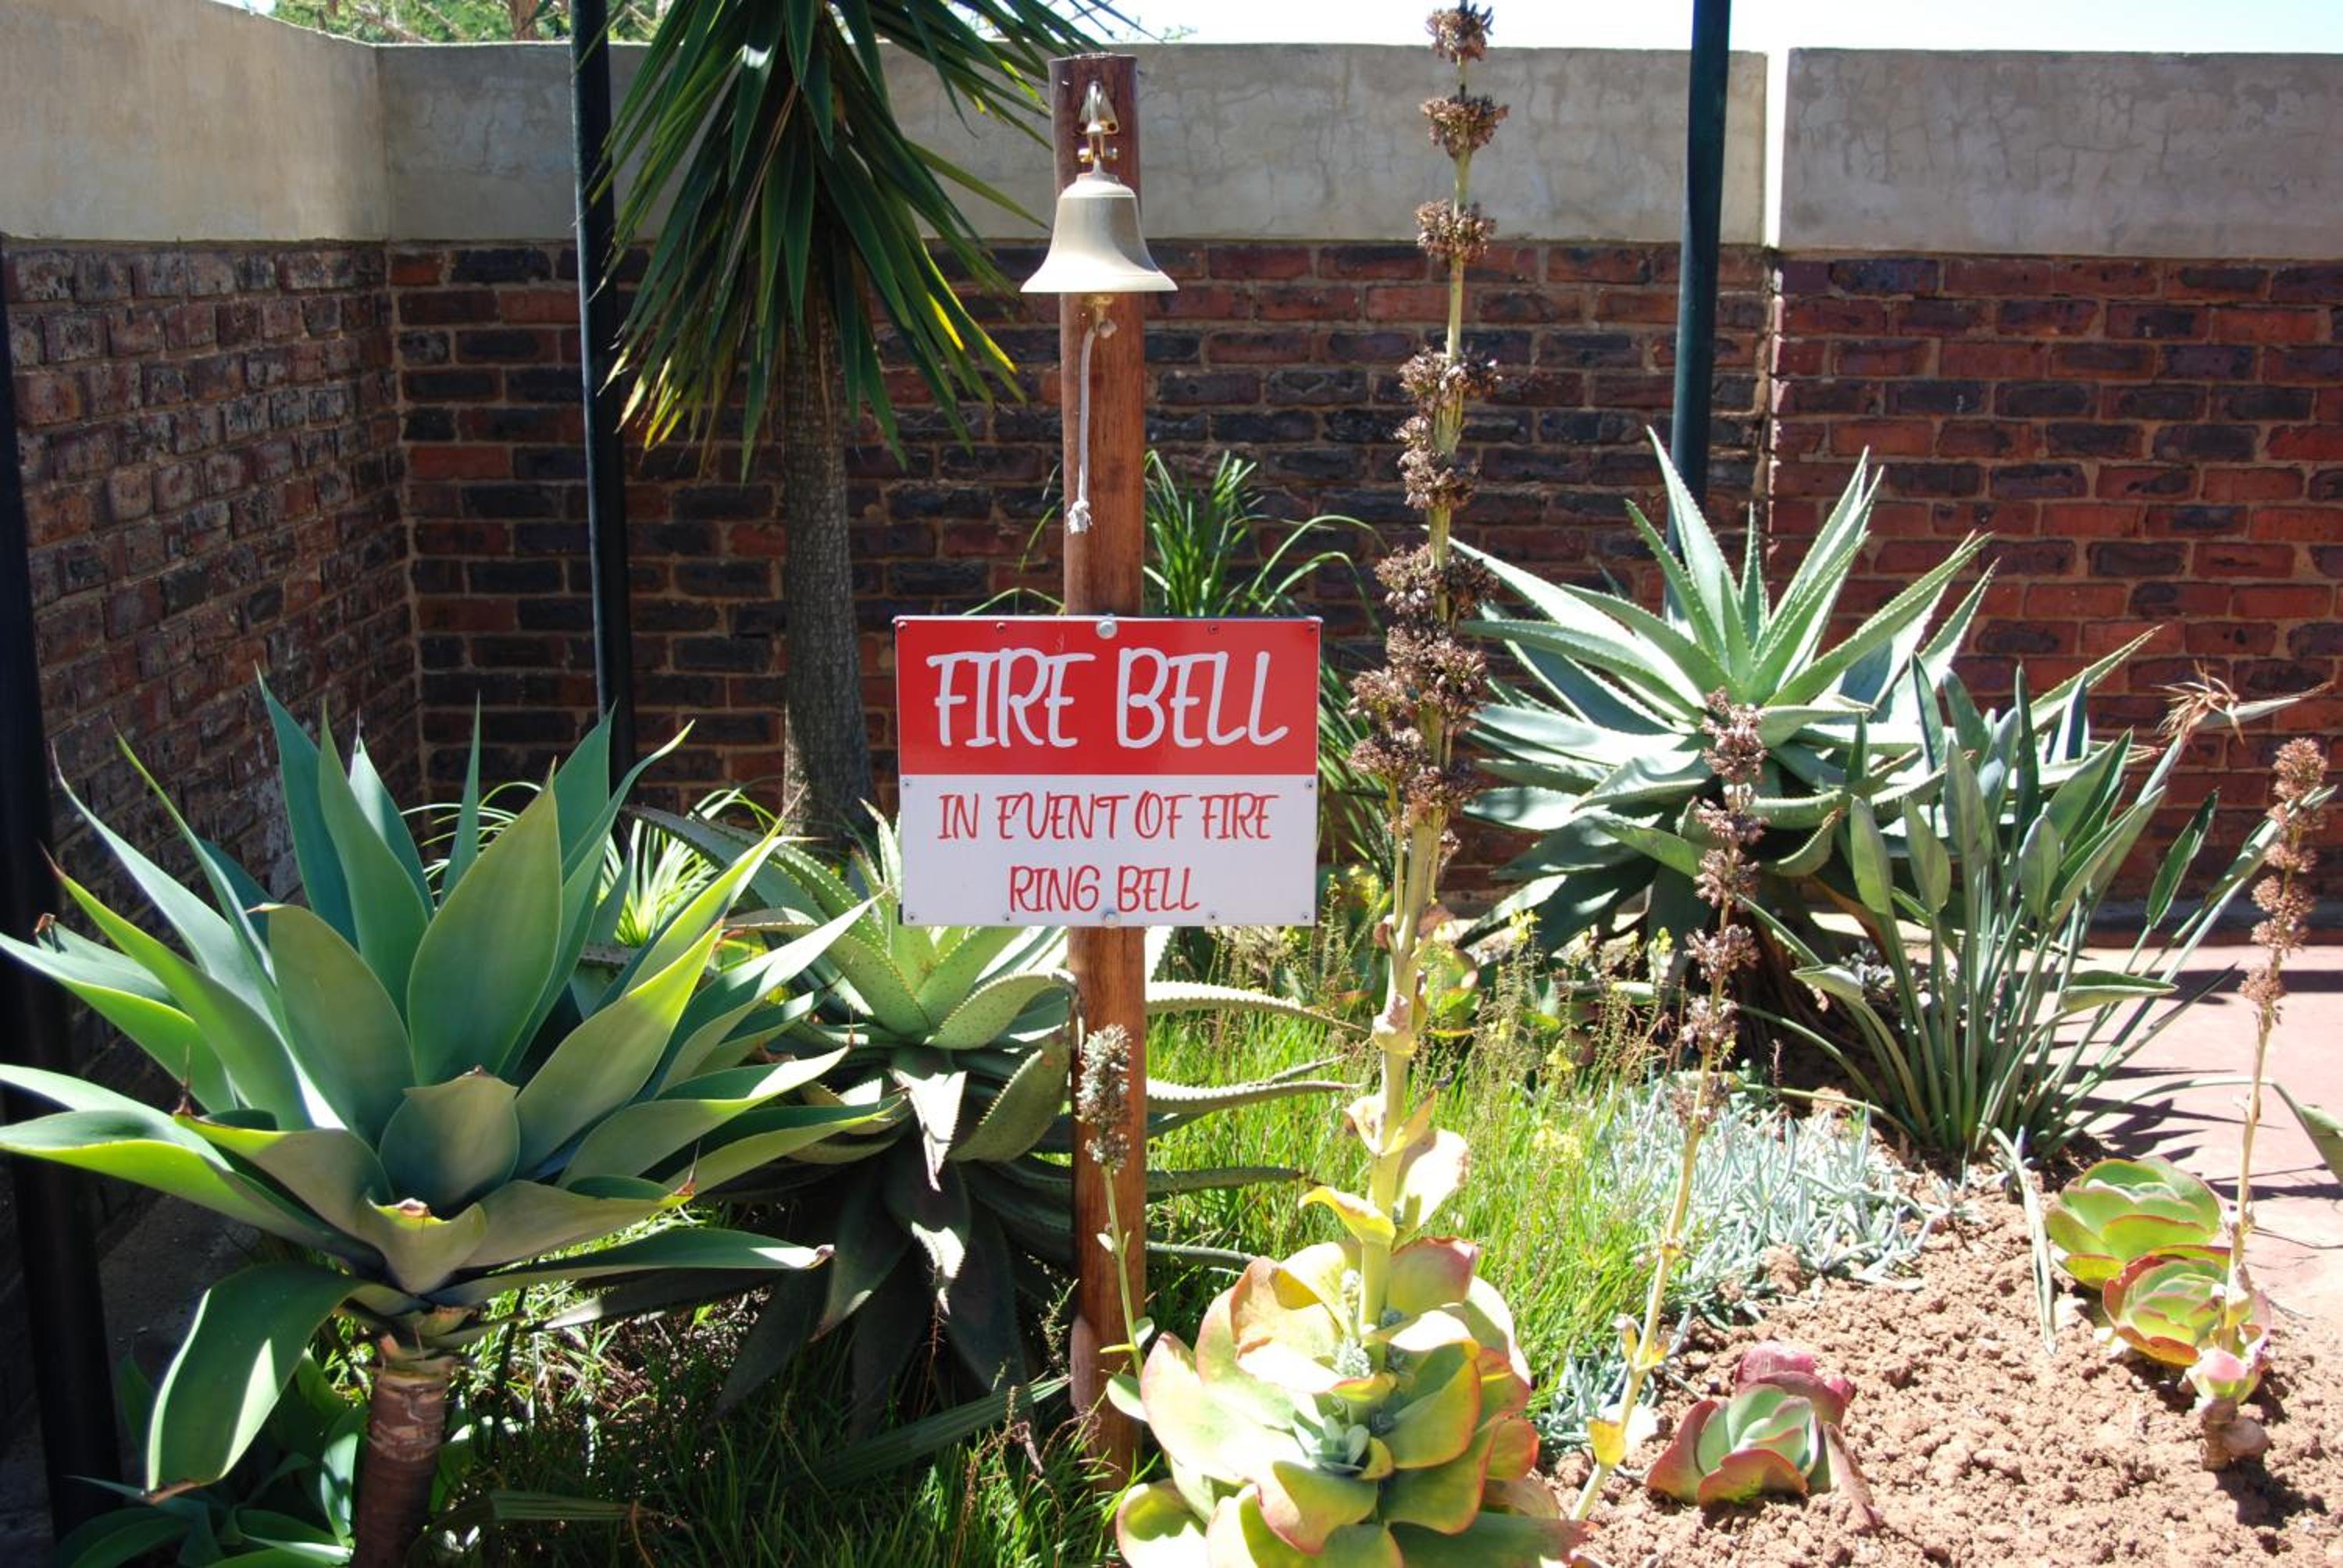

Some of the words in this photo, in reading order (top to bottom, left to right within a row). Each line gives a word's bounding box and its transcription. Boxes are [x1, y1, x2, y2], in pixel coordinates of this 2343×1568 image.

[926, 647, 1096, 747] FIRE
[1116, 647, 1289, 748] BELL
[938, 793, 979, 839] IN
[997, 791, 1129, 839] EVENT
[1134, 790, 1193, 839] OF
[1199, 793, 1279, 839] FIRE
[1009, 865, 1100, 912] RING
[1117, 865, 1200, 912] BELL
